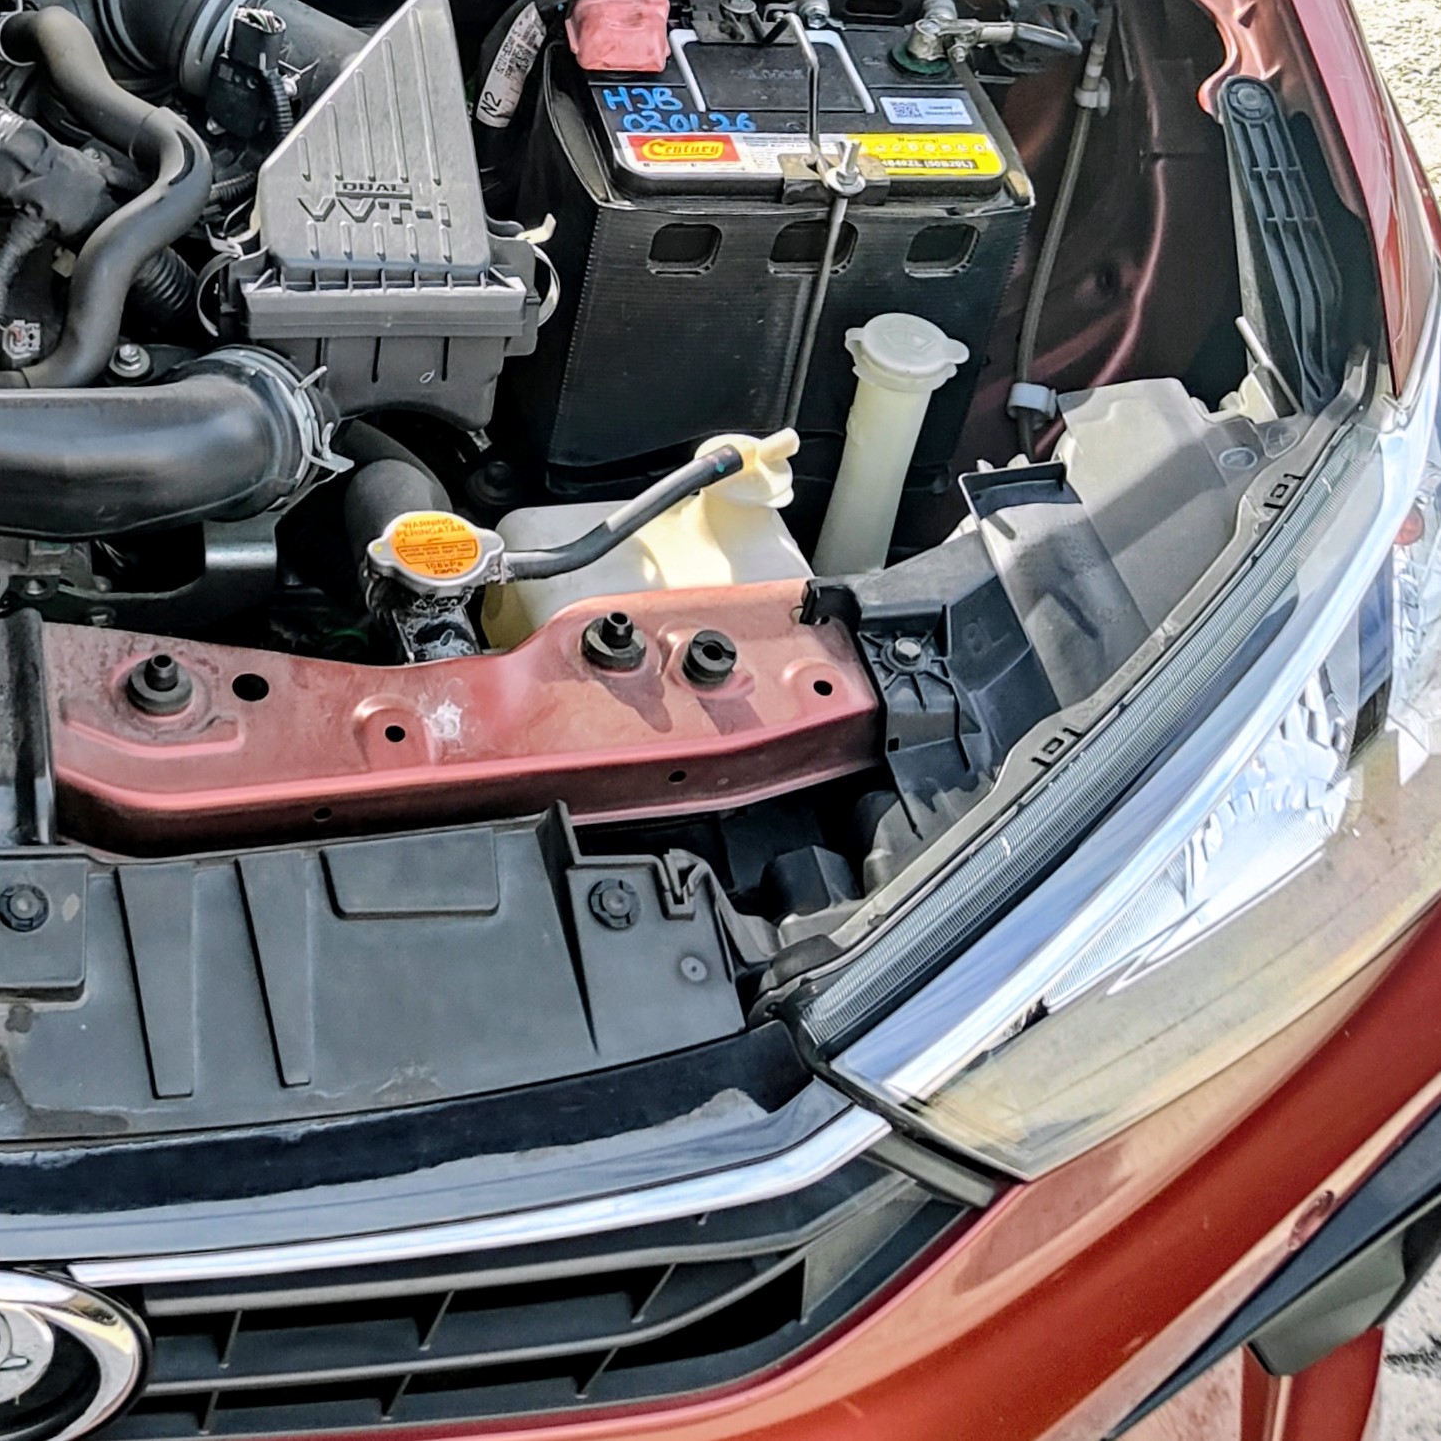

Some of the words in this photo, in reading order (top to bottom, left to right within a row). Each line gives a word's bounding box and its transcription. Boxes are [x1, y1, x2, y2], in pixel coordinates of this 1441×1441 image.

[480, 91, 502, 117] N2
[648, 140, 722, 157] Century
[342, 182, 404, 192] DUAL
[401, 518, 454, 529] WARNING
[395, 525, 465, 537] PERINGATAN
